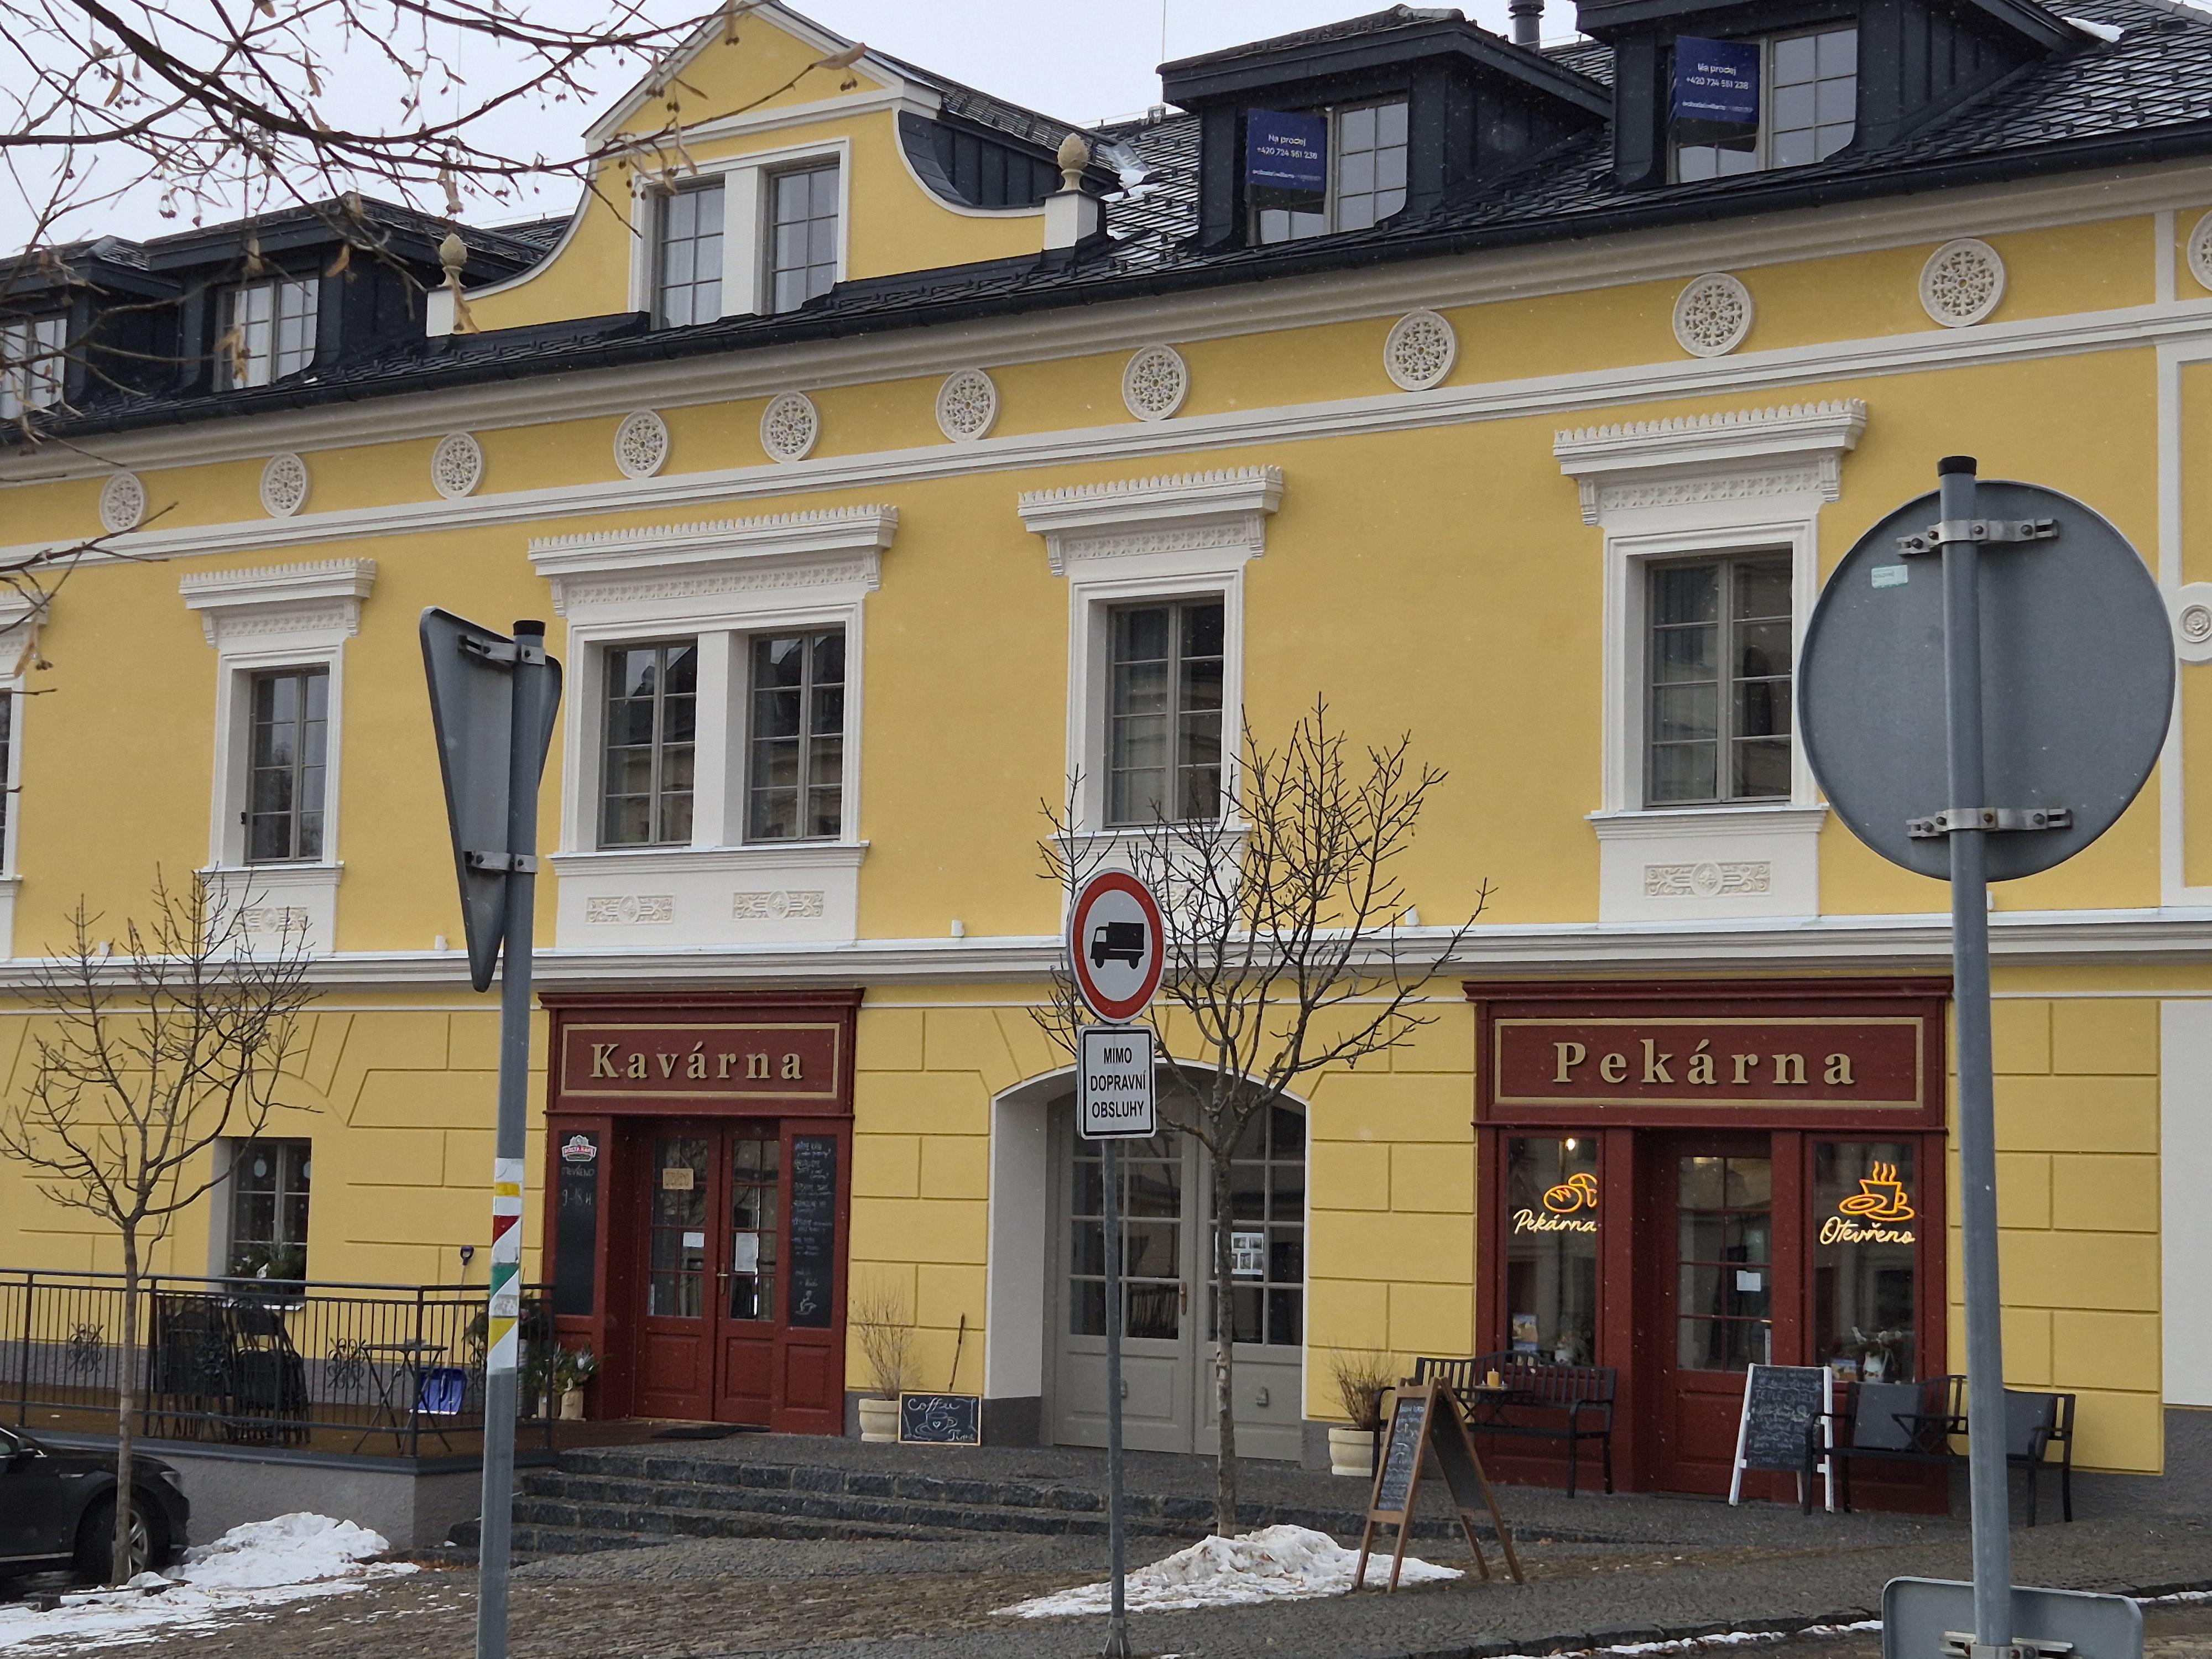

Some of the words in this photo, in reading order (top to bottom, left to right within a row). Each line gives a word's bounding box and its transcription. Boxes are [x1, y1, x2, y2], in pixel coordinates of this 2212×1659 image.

[589, 1041, 803, 1079] Kavárna
[1103, 1047, 1133, 1064] MIMO
[1552, 1039, 1855, 1085] Pekárna
[1090, 1070, 1146, 1092] DOPRAVNÍ
[1092, 1100, 1144, 1118] OBSLUHY
[1513, 1209, 1598, 1235] Pekárna
[1819, 1217, 1916, 1245] Otevřeno
[907, 1397, 961, 1413] Coffee
[945, 1429, 975, 1442] Time
